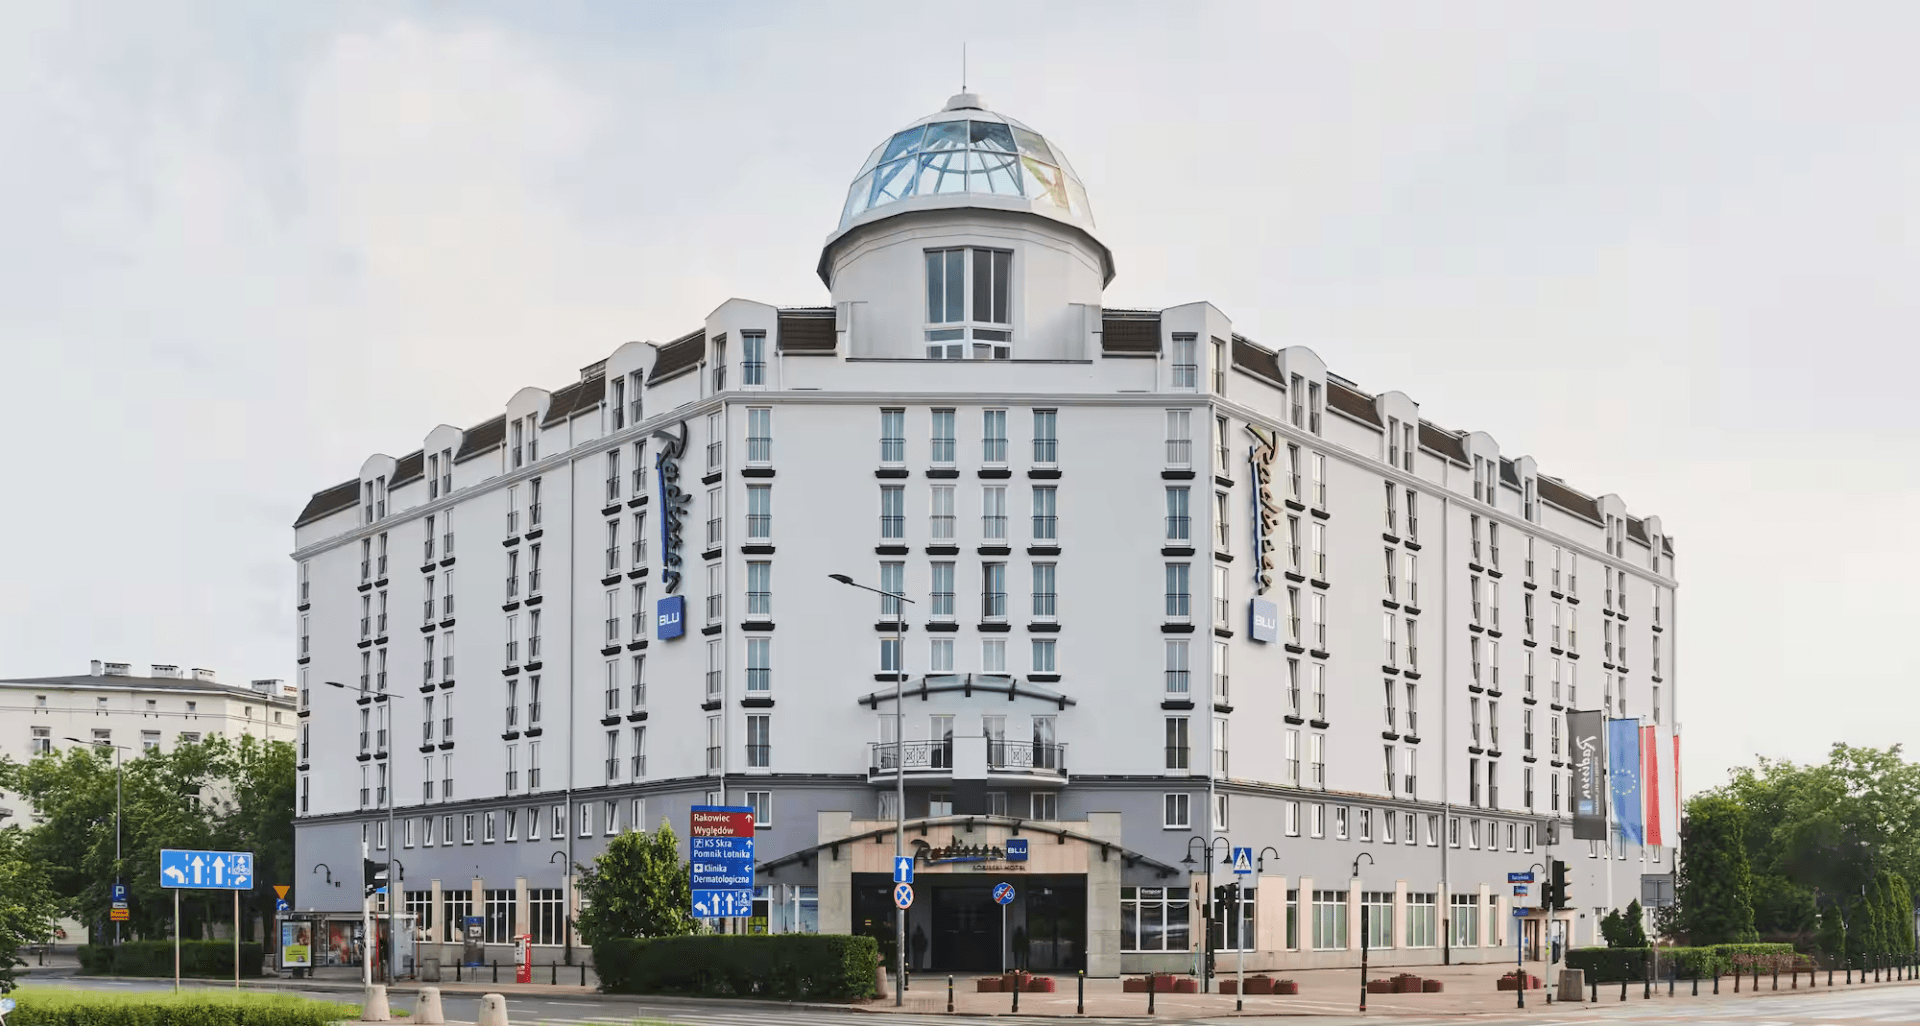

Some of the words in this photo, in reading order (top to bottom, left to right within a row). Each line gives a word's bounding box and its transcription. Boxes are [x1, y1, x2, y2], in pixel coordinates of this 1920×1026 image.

[658, 611, 680, 626] BLU
[1254, 614, 1276, 629] BLU
[694, 814, 730, 822] Rakowiec
[694, 826, 734, 836] Wyględów
[704, 839, 715, 848] KS
[715, 839, 732, 848] Skra
[694, 850, 721, 858] Pomnik
[724, 850, 750, 858] Lotnika
[704, 864, 727, 872] Klinika
[694, 875, 750, 884] Dermatologiczna
